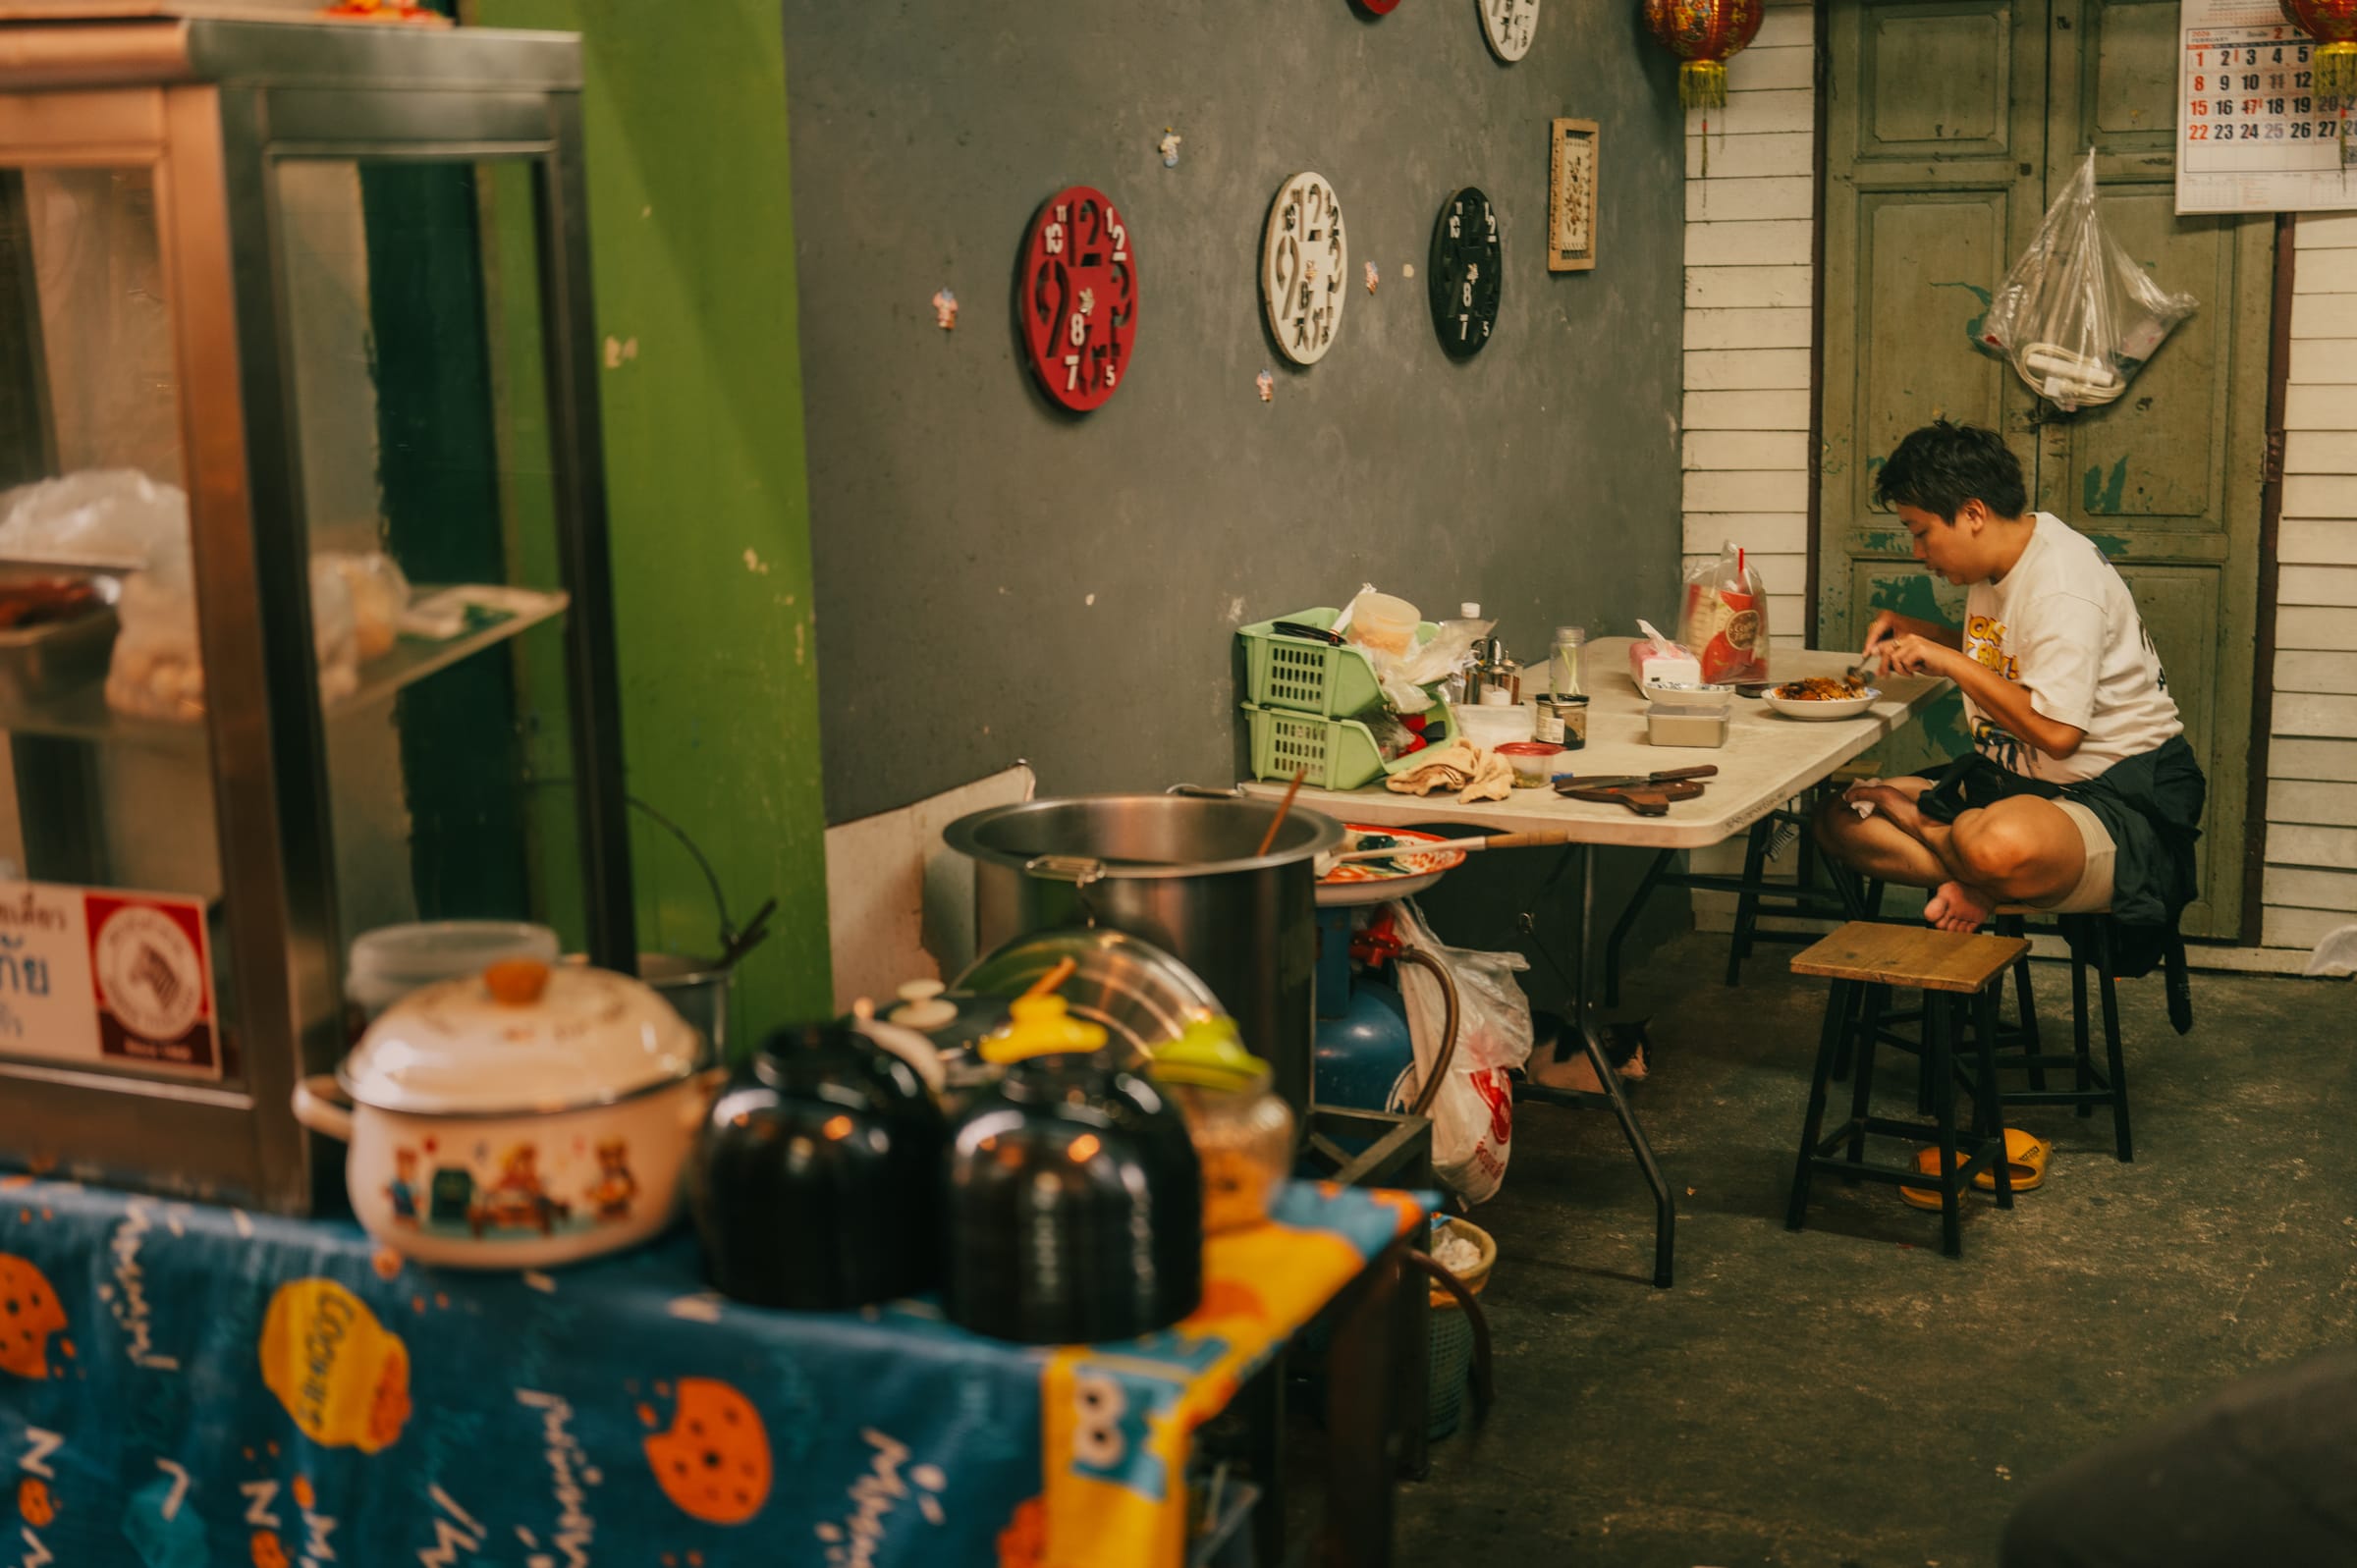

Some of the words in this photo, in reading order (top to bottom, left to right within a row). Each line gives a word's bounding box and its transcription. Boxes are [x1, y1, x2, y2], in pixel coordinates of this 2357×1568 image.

[2196, 52, 2204, 67] 1
[2220, 50, 2229, 66] 2
[2246, 49, 2256, 65] 3
[2272, 48, 2282, 64] 4
[2298, 46, 2308, 63] 5
[2194, 76, 2204, 91] 8
[2220, 75, 2229, 90] 9
[2242, 74, 2259, 89] 10
[2270, 74, 2285, 89] 11
[2295, 72, 2312, 88] 12
[2191, 100, 2208, 116] 15
[2217, 99, 2233, 115] 16
[2242, 99, 2258, 115] 17
[2267, 98, 2284, 114] 18
[2293, 97, 2311, 113] 19
[2189, 125, 2208, 140] 22
[2215, 124, 2233, 139] 23
[2240, 123, 2259, 139] 24
[2264, 123, 2283, 138] 25
[2290, 122, 2311, 138] 26
[2318, 121, 2337, 137] 27
[1056, 204, 1068, 223] 11
[1106, 206, 1115, 234] 1
[1045, 223, 1064, 254] 10
[1068, 199, 1102, 267] 12
[1449, 215, 1461, 240] 10
[1488, 214, 1497, 243] 2
[1113, 225, 1127, 262] 2
[1462, 282, 1472, 308] 8
[1035, 260, 1071, 358] 9
[1070, 313, 1085, 347] 8
[1459, 313, 1469, 341] 7
[1481, 320, 1490, 338] 5
[1065, 354, 1079, 391] 7
[1106, 365, 1116, 387] 5
